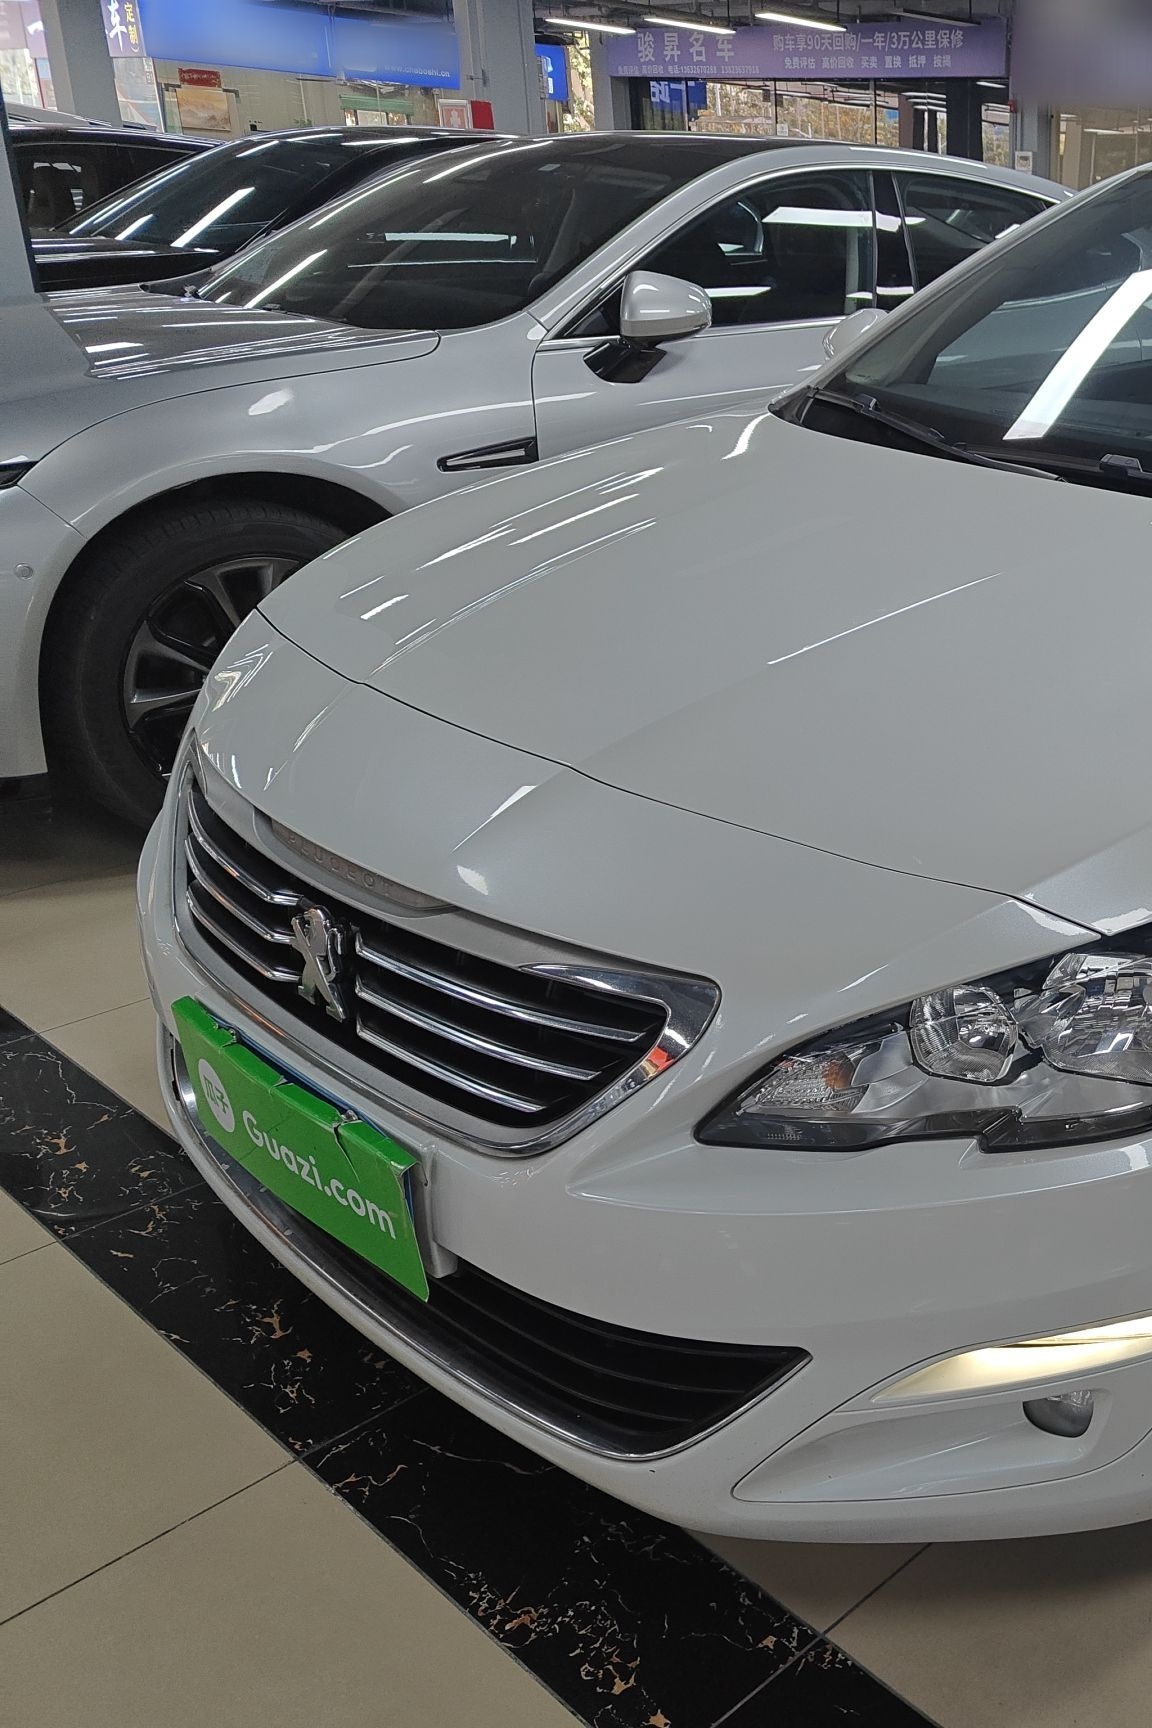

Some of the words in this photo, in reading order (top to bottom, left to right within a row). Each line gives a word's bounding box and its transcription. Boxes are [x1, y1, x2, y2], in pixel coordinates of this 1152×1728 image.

[637, 31, 735, 62] 骏昇名车
[784, 56, 816, 69] 免费评估
[822, 56, 854, 69] 高价回收
[861, 56, 878, 68] 买卖
[242, 1110, 396, 1240] Guazi.com
